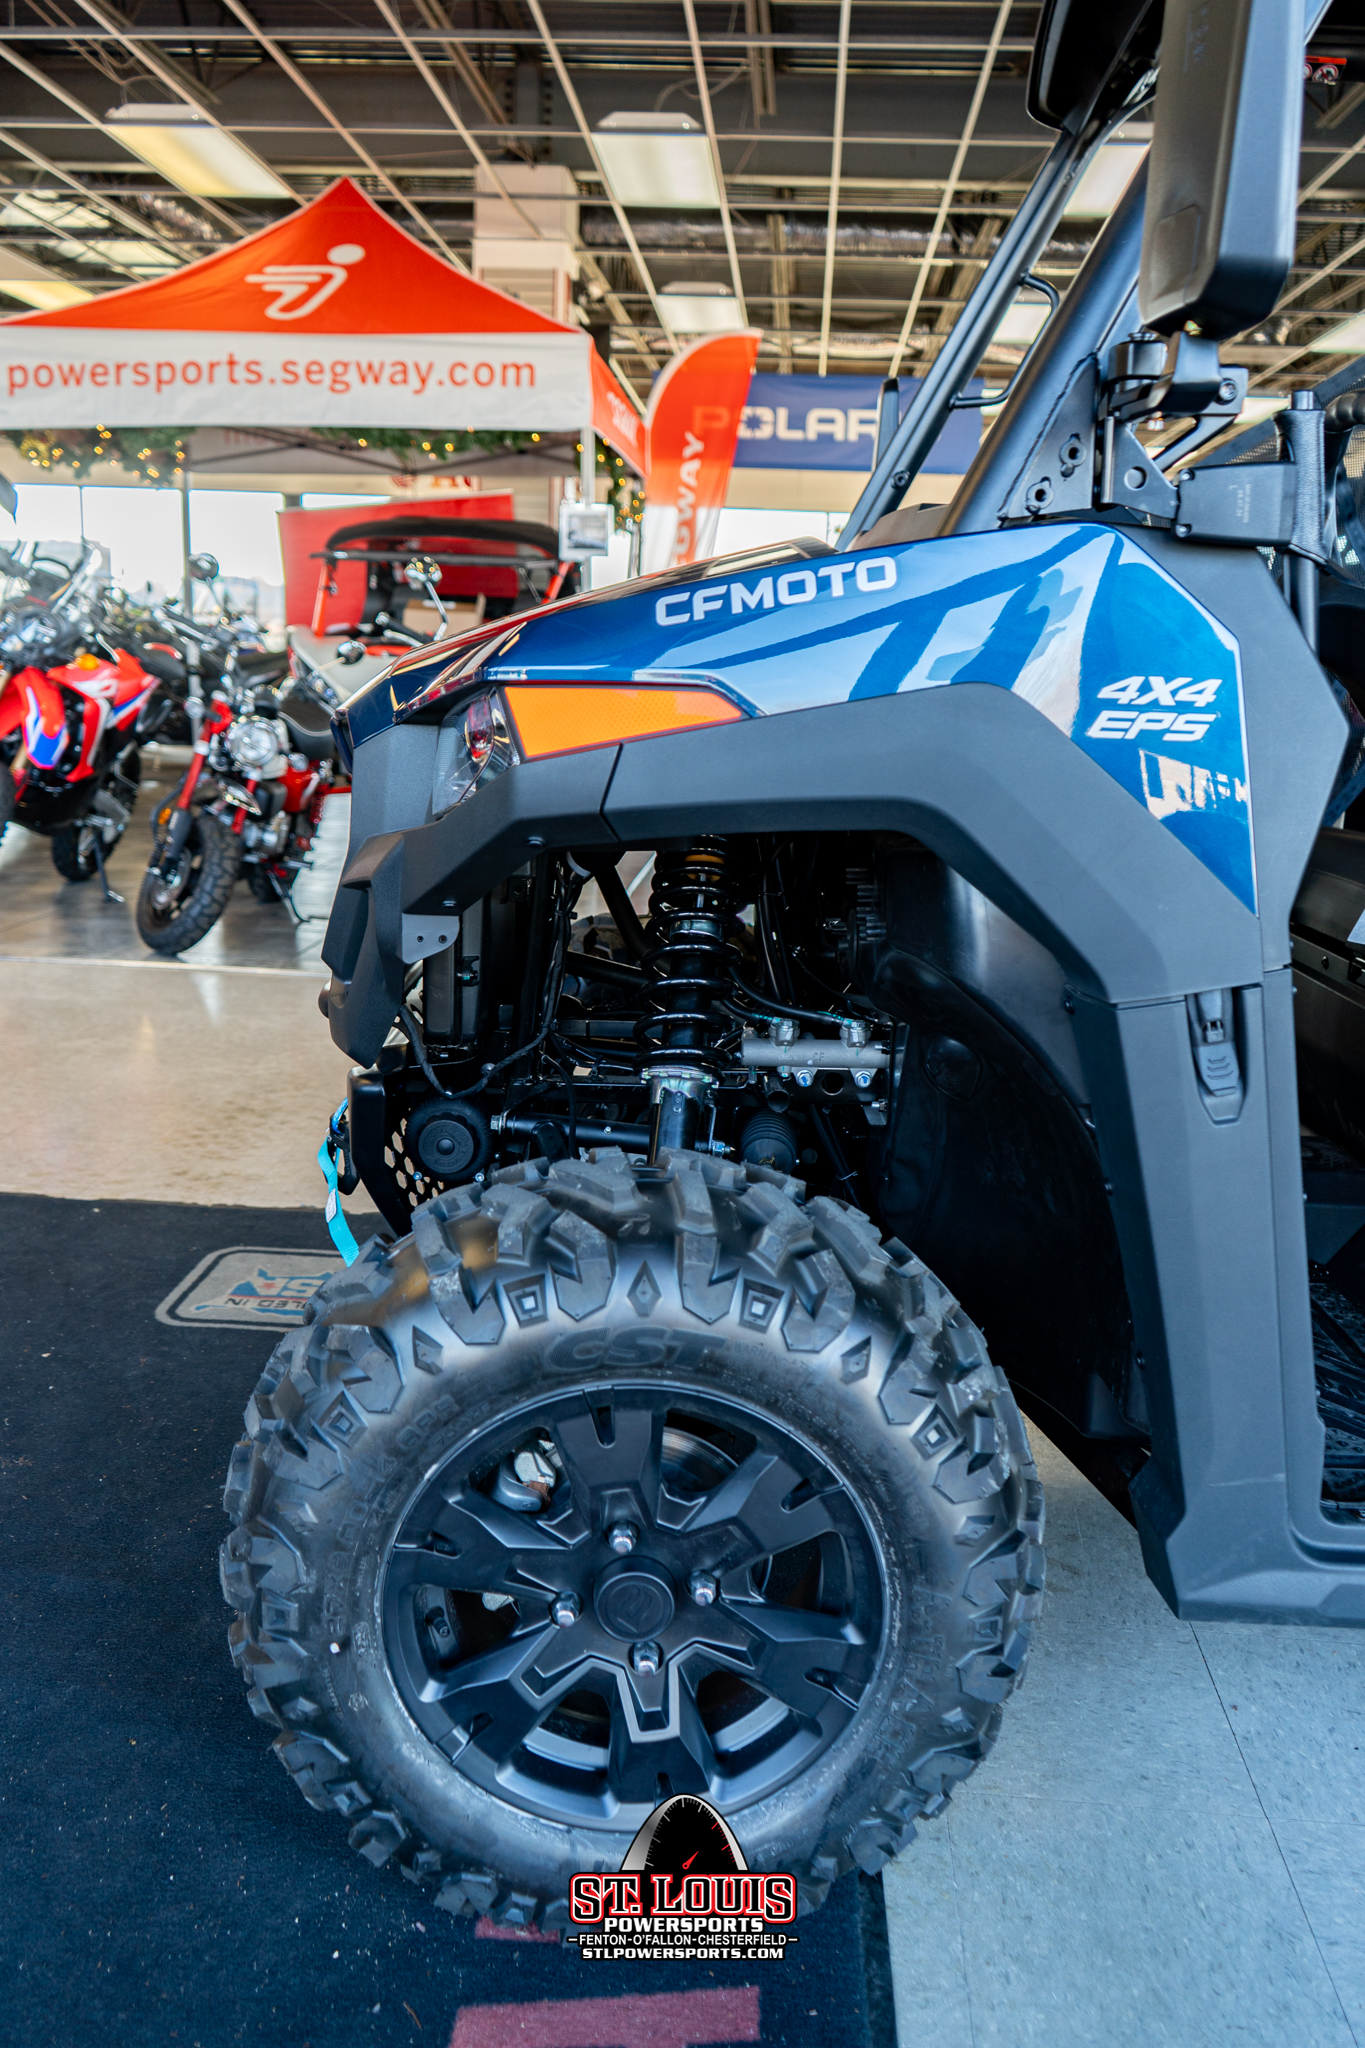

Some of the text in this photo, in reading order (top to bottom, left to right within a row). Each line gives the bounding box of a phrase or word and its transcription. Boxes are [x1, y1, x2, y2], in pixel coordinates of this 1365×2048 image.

[7, 351, 537, 397] powersports.segway.com
[692, 404, 879, 443] POLAR
[655, 556, 898, 627] CFMOTO
[1096, 675, 1223, 708] 4X4
[1086, 709, 1218, 742] EPS
[224, 1298, 308, 1310] LED IN
[256, 1277, 323, 1297] SA
[546, 1326, 729, 1372] CST
